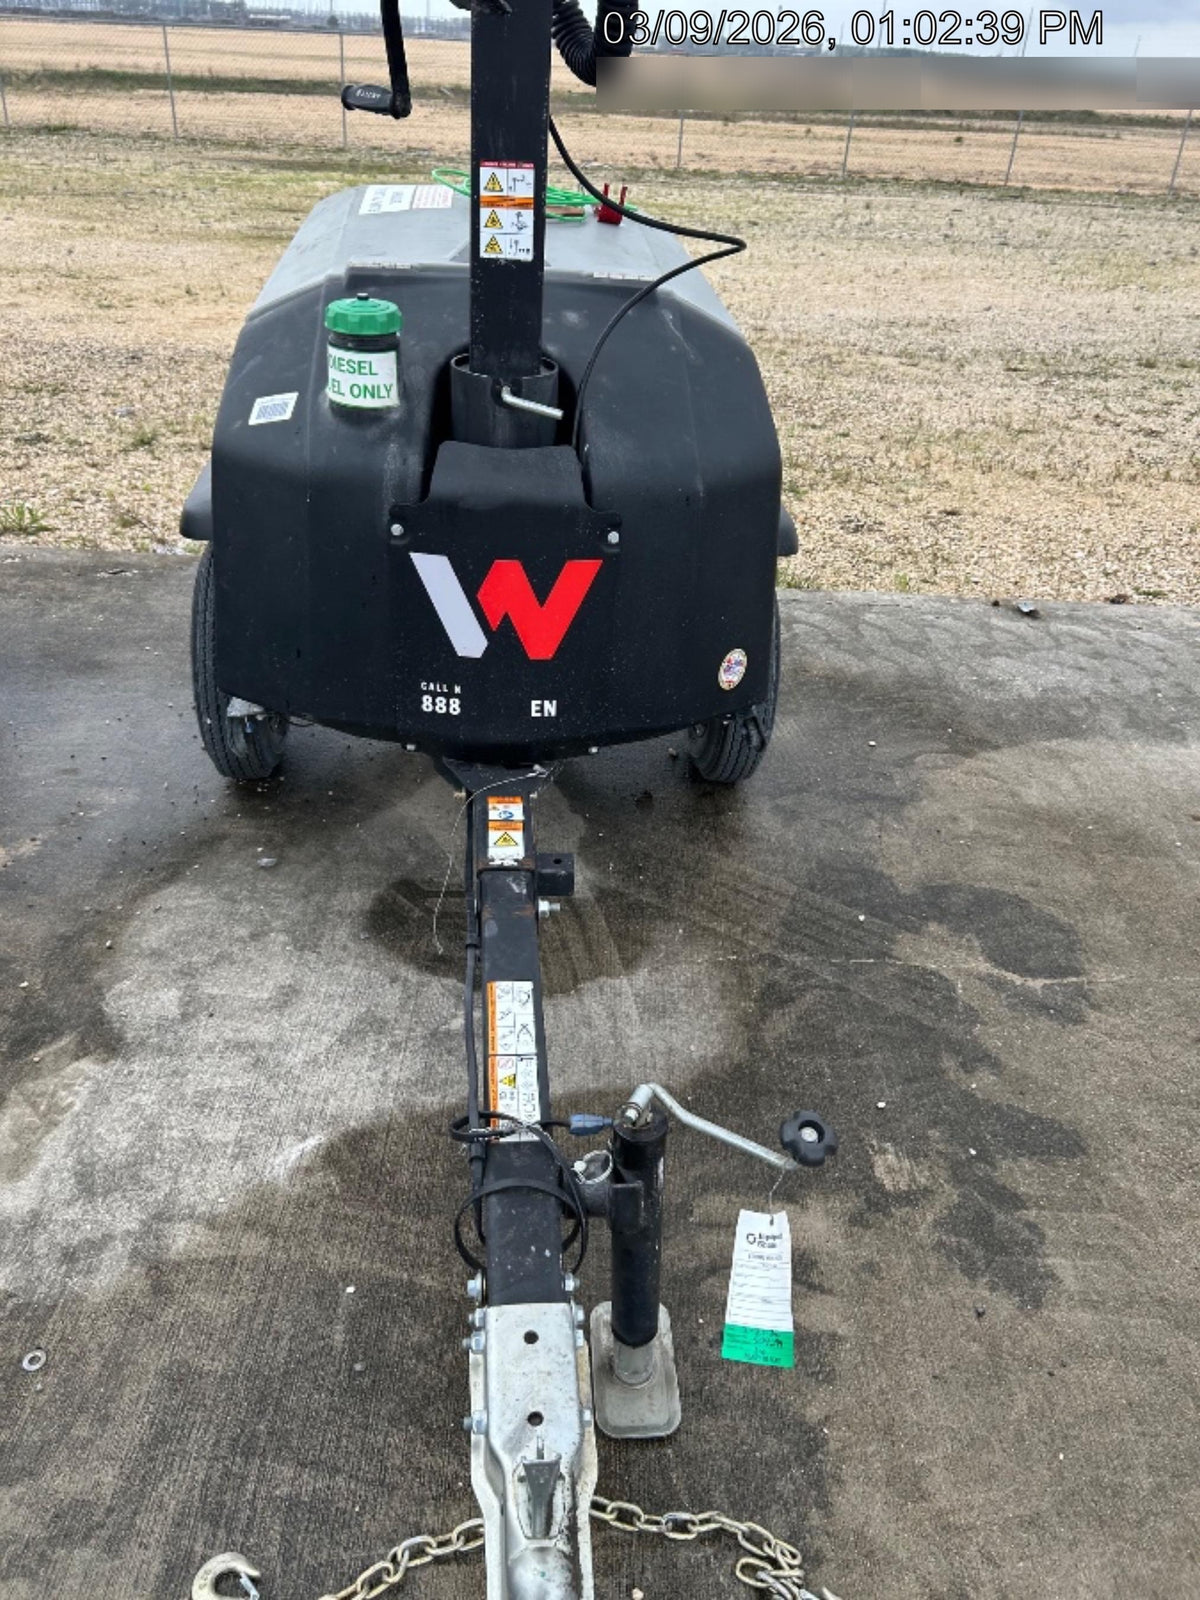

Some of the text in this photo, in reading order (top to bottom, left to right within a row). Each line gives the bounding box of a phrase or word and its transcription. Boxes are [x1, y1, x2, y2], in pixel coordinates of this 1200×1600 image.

[350, 384, 393, 399] ONLY
[420, 681, 449, 692] CALL
[421, 694, 557, 717] 888 EN
